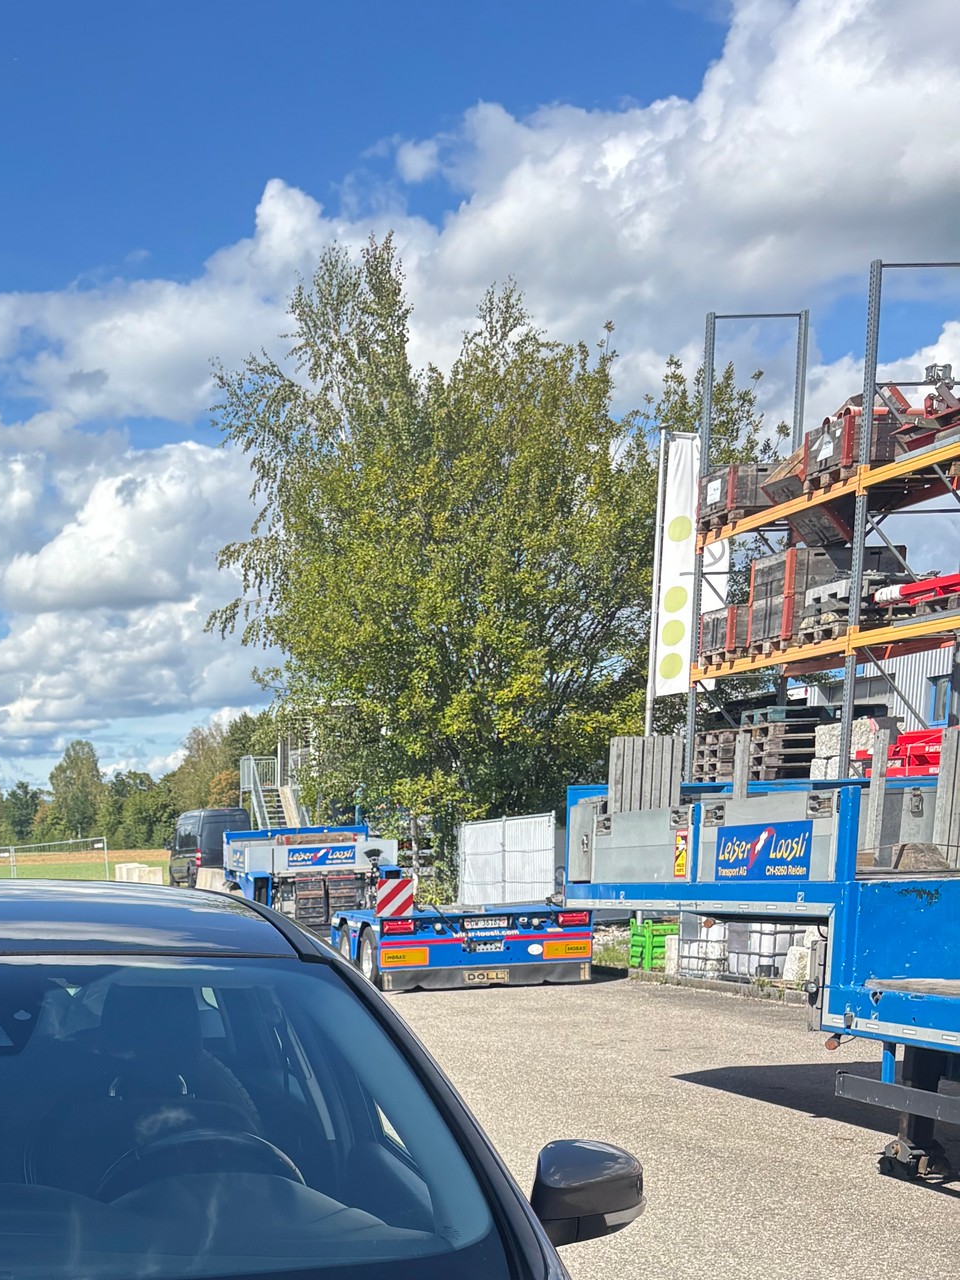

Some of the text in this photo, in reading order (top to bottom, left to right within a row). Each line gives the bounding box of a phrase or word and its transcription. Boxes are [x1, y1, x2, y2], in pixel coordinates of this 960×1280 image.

[718, 832, 809, 863] Leiser Loosli
[718, 866, 747, 878] Transport AG
[788, 865, 806, 875] Reiden
[468, 972, 505, 980] DOLL
